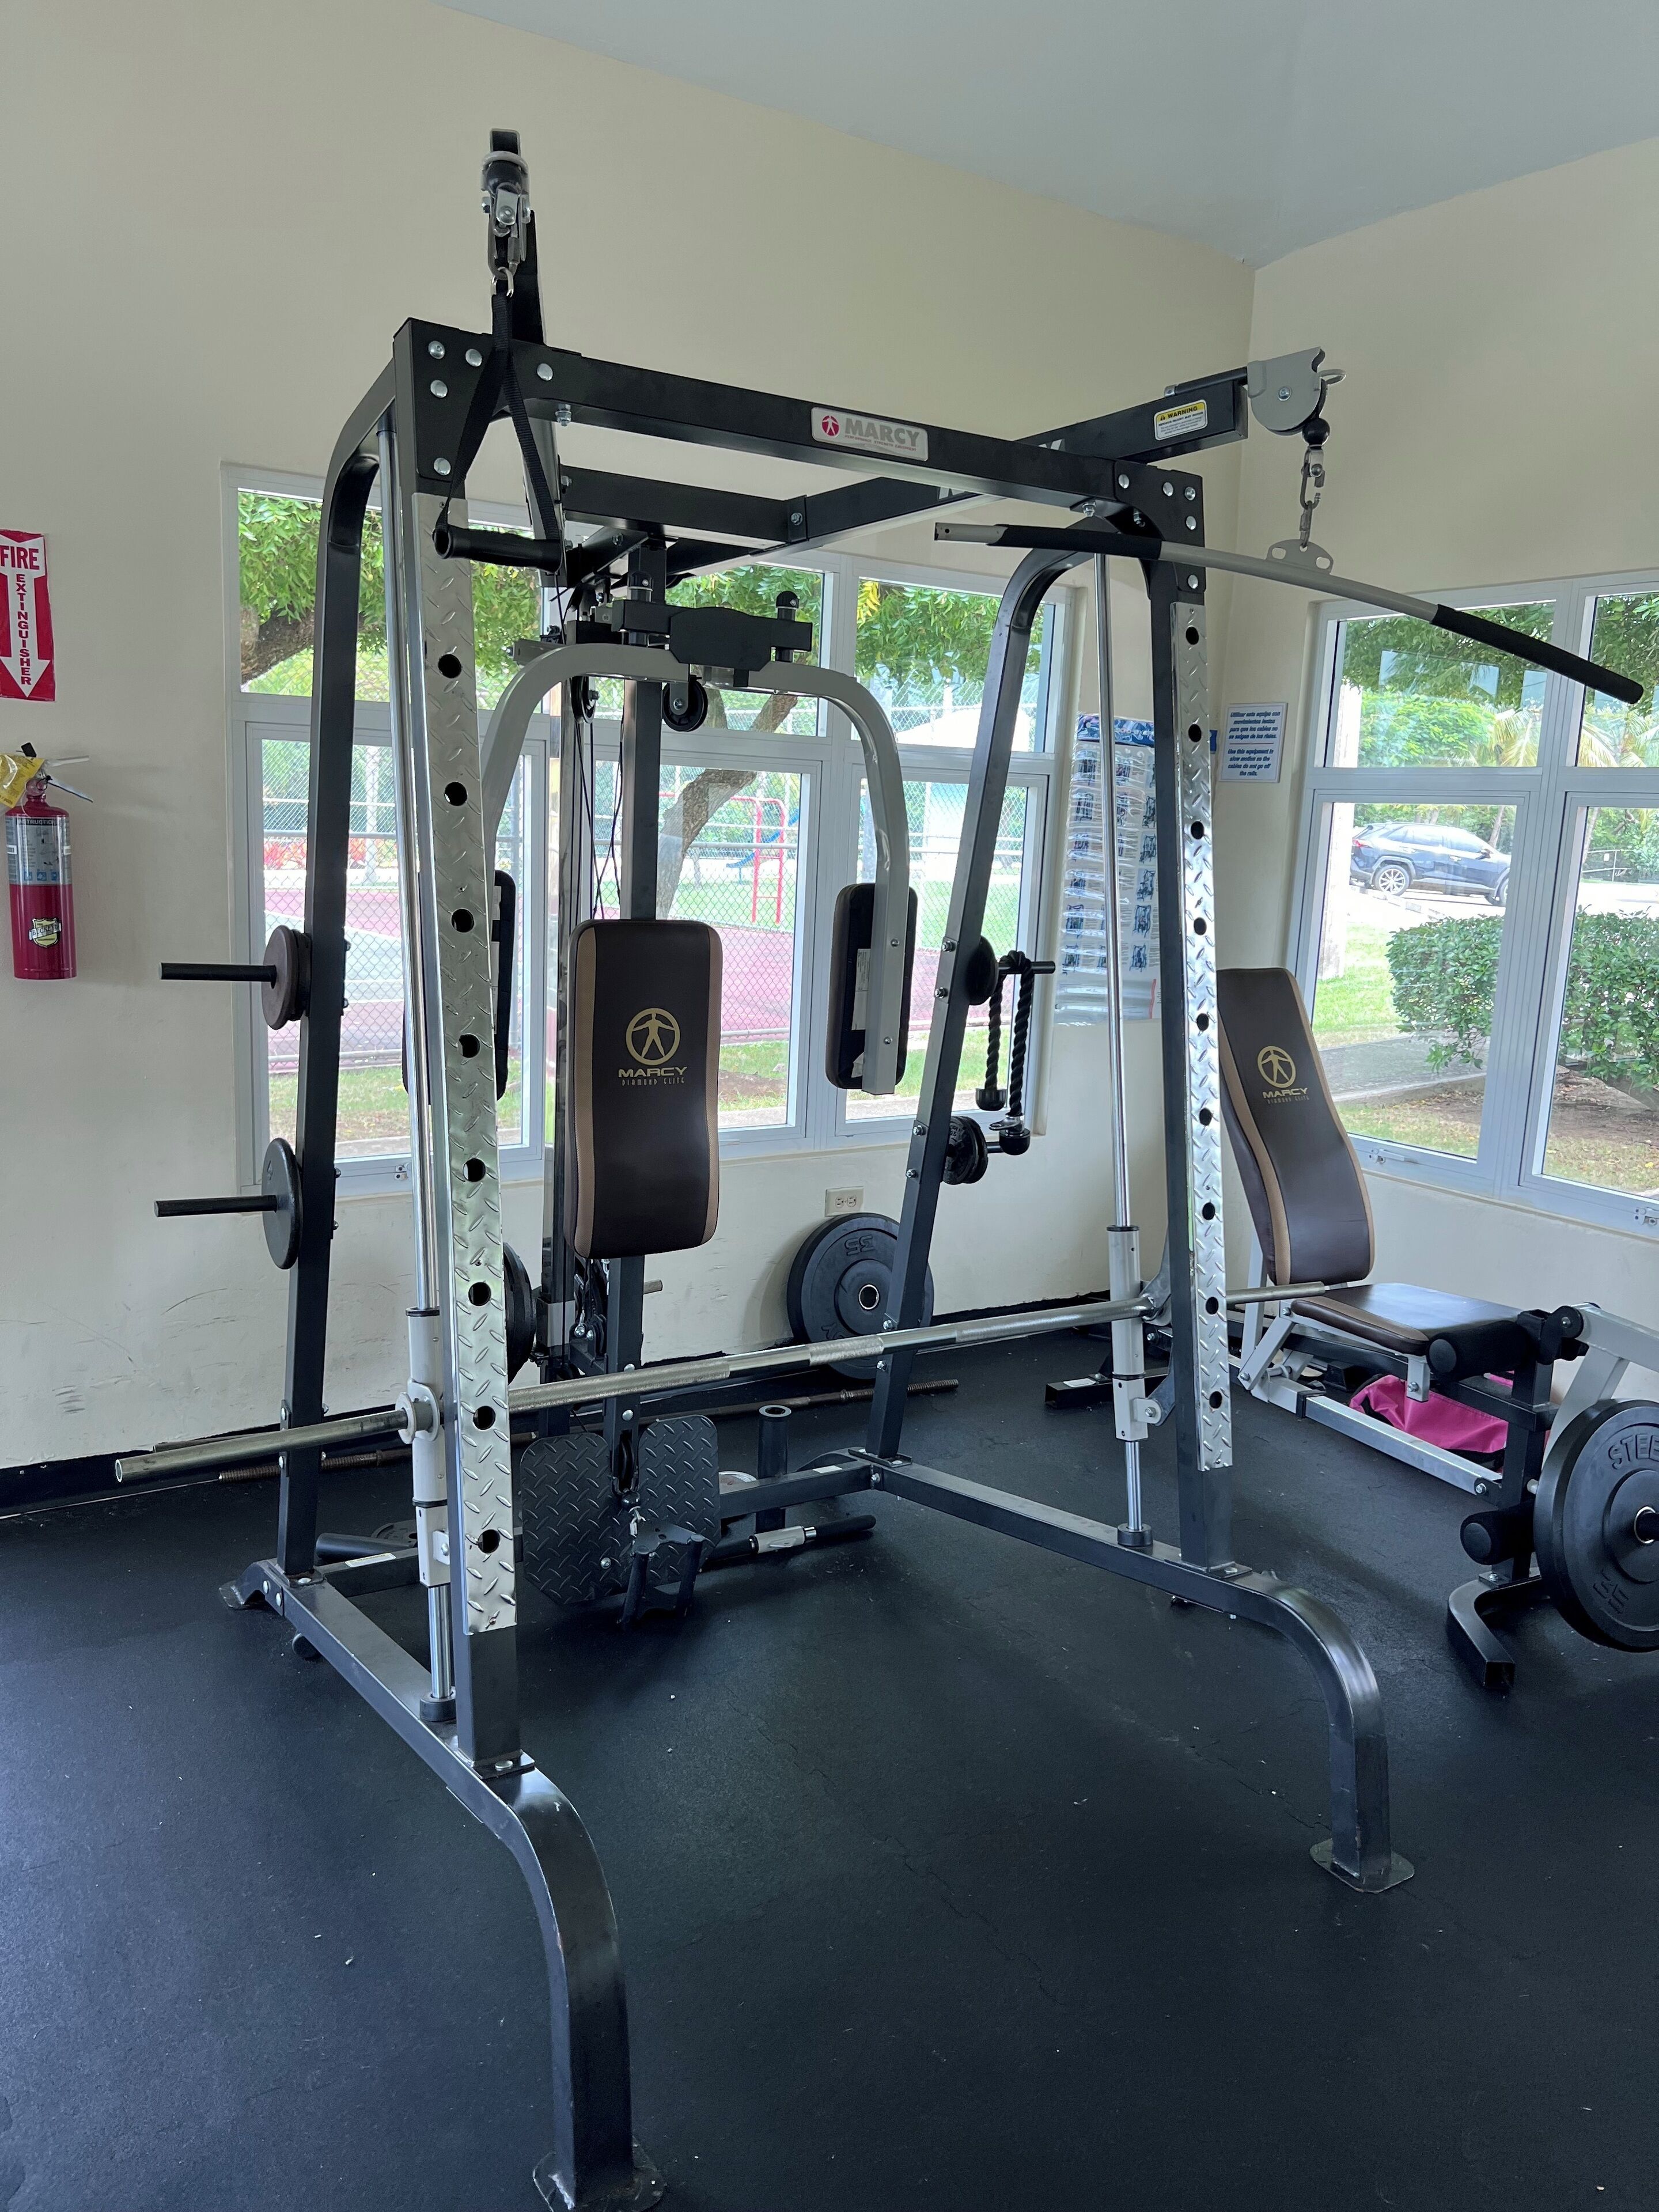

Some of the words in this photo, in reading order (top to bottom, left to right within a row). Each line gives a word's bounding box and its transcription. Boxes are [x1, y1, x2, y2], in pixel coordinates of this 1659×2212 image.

[1168, 406, 1198, 418] WARNING
[845, 418, 920, 447] MARCY
[0, 545, 40, 570] FIRE
[16, 573, 32, 685] EXTINGUISHER
[618, 1066, 688, 1078] MARCY
[1263, 1088, 1308, 1099] MARCY
